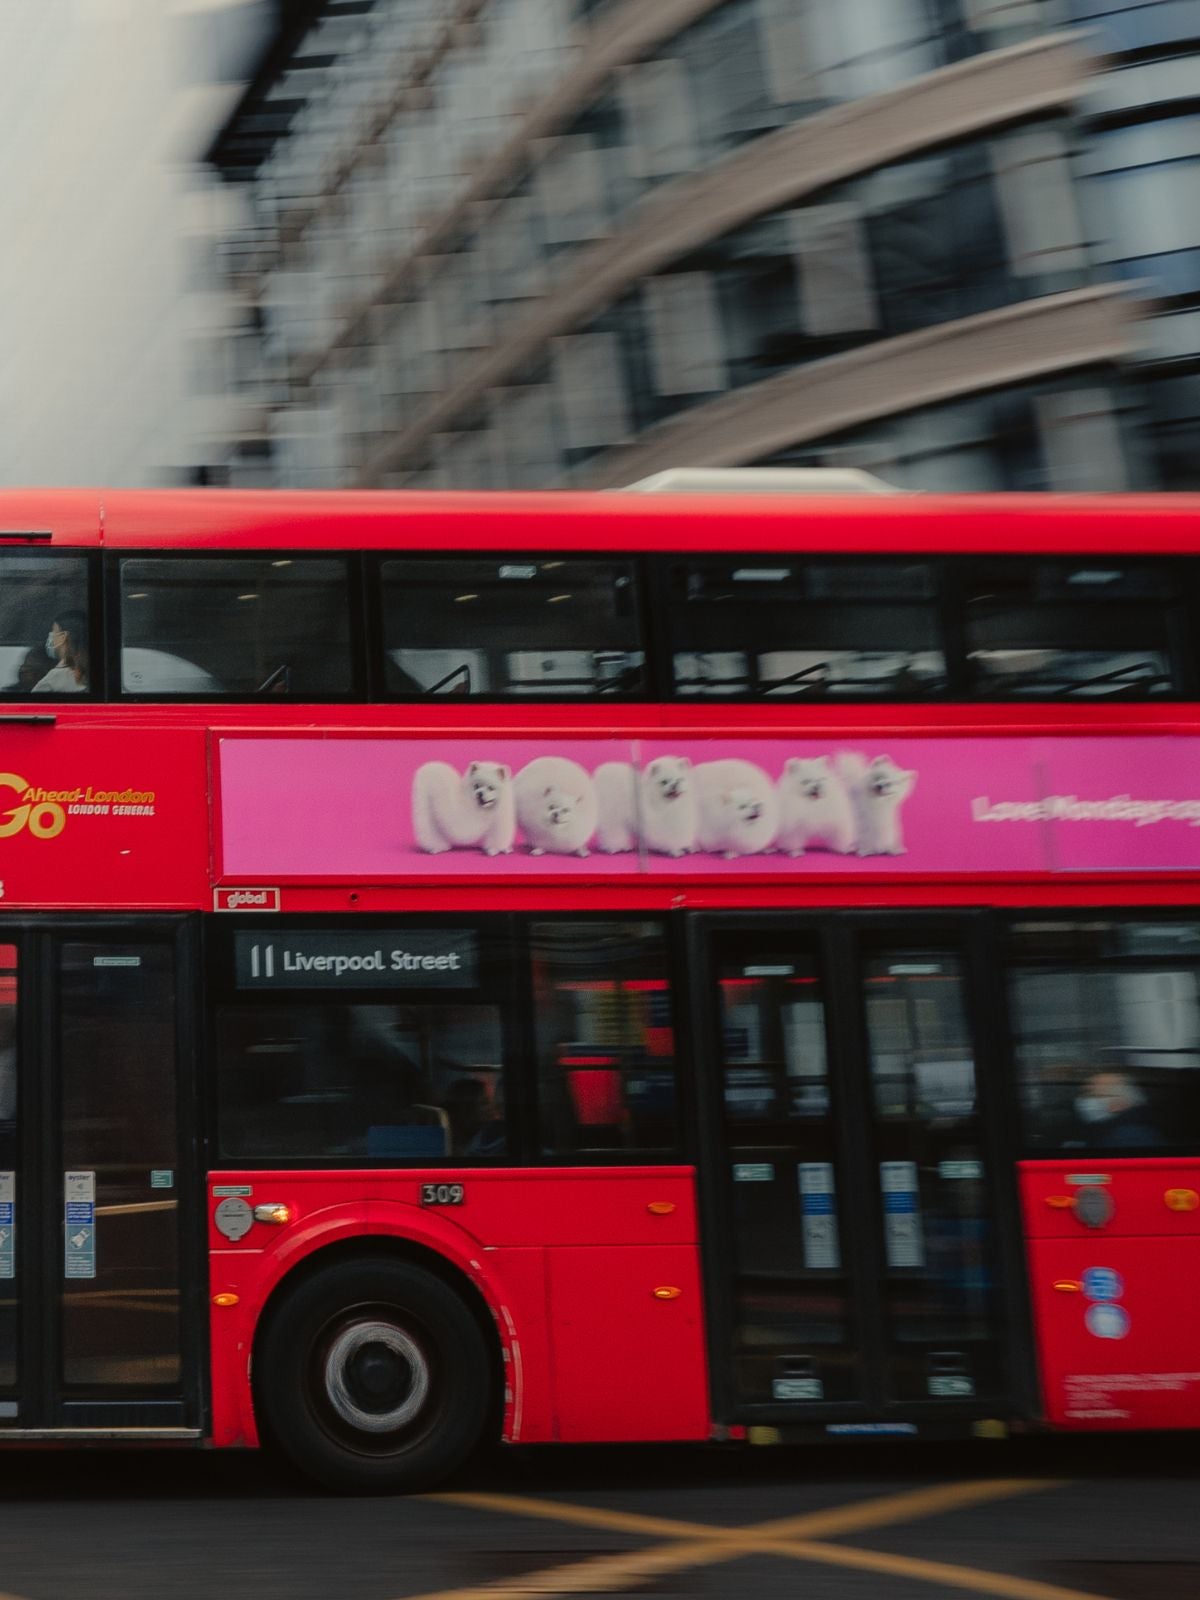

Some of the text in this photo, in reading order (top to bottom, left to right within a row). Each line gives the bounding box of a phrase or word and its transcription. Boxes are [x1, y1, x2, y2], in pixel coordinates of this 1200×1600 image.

[68, 804, 155, 817] LONDON GENERAL
[227, 891, 267, 907] global
[251, 945, 461, 978] 11 Liverpool Street
[422, 1185, 463, 1204] 309
